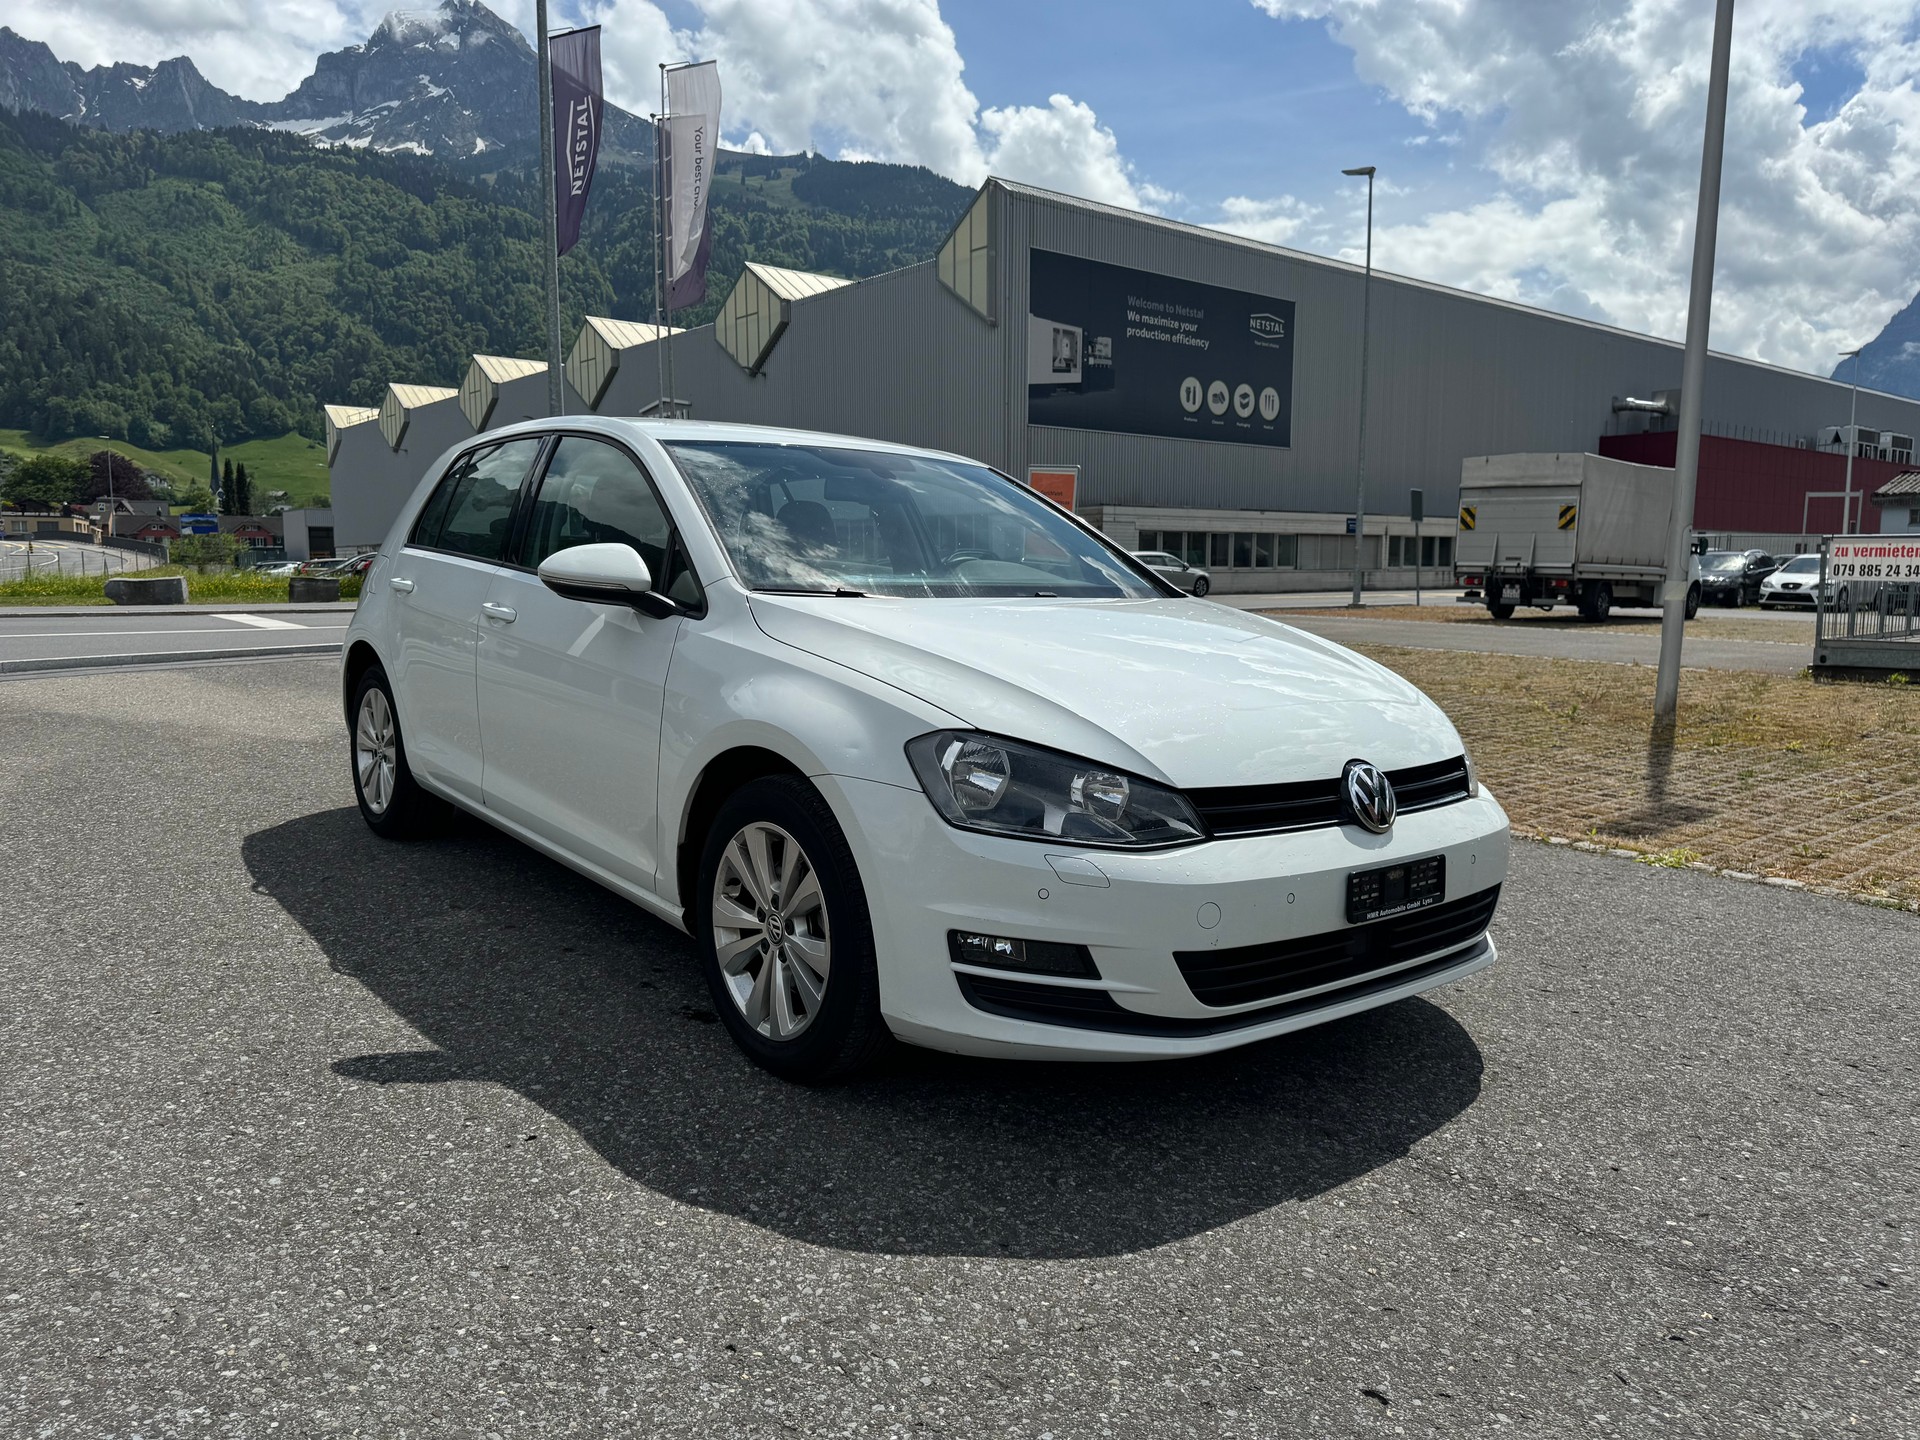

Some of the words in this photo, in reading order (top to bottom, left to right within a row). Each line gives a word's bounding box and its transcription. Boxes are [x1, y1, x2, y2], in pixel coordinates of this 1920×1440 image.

[571, 96, 588, 196] NETSTAL
[694, 126, 704, 155] Your
[694, 157, 704, 184] best
[1127, 295, 1164, 312] Welcome
[1165, 303, 1174, 314] to
[1175, 304, 1204, 319] Netstal
[1127, 310, 1140, 322] We
[1141, 314, 1179, 329] maximize
[1180, 322, 1198, 333] your
[1250, 318, 1284, 333] NETSTAL
[1126, 327, 1171, 342] production
[1171, 333, 1210, 351] efficiency
[1834, 546, 1849, 558] zu
[1833, 563, 1855, 577] 079
[1859, 564, 1882, 577] 885
[1885, 564, 1900, 577] 24
[1904, 564, 1920, 578] 34
[1379, 904, 1406, 917] Automobile
